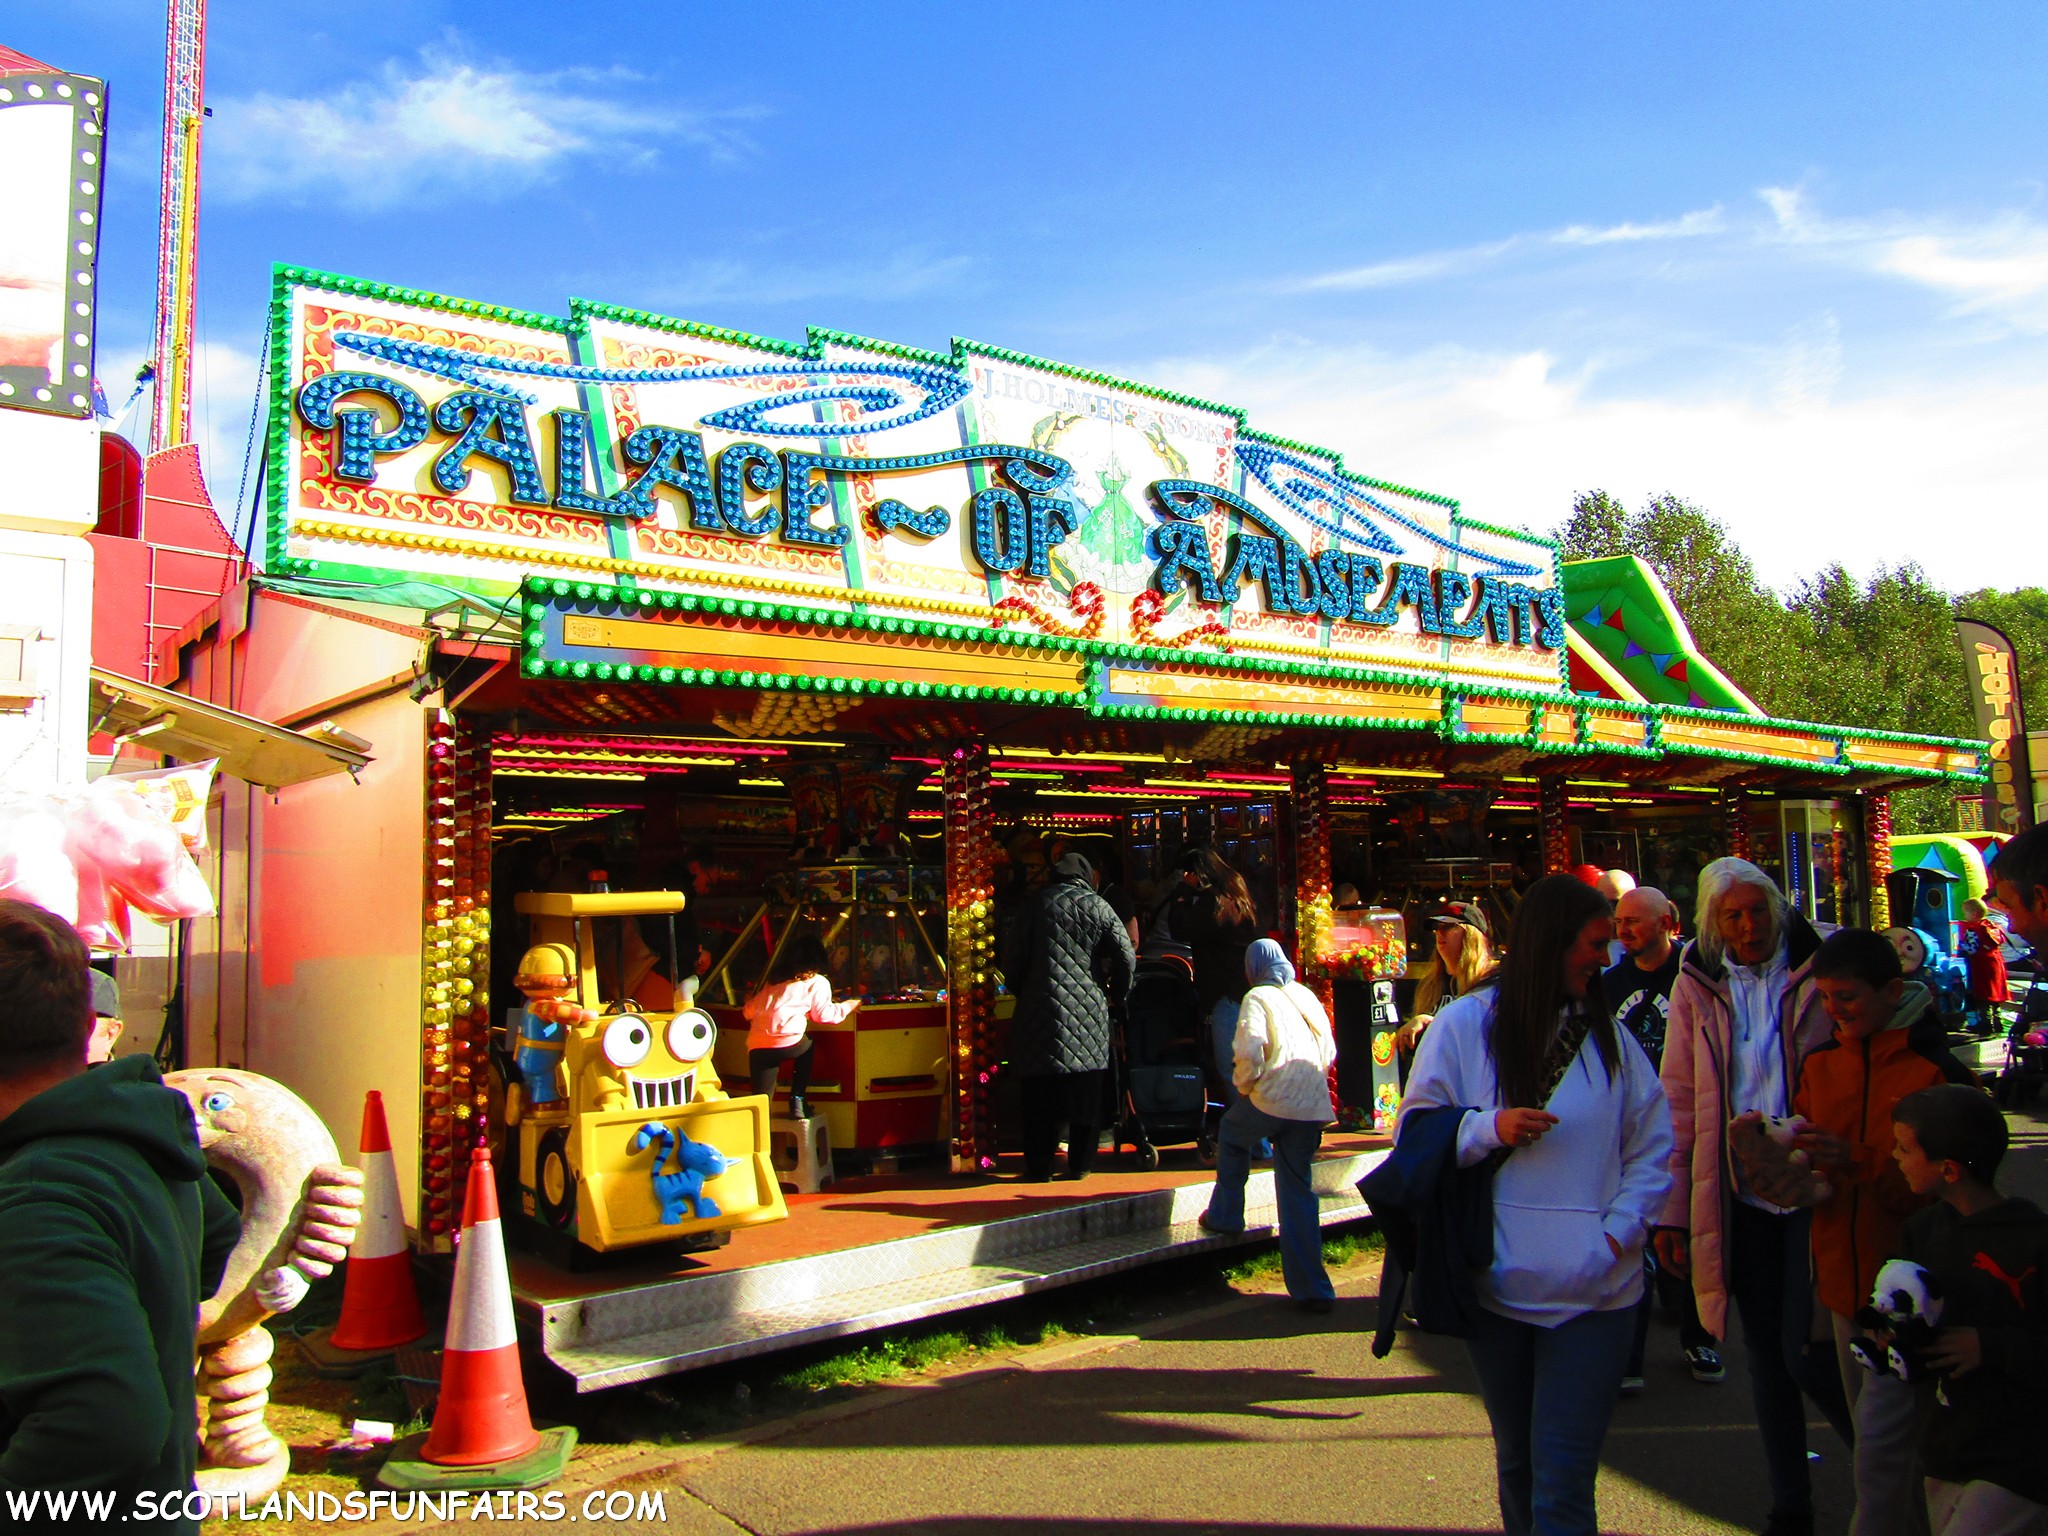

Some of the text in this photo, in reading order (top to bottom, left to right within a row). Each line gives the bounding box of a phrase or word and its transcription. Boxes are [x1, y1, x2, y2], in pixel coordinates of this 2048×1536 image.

[1164, 412, 1226, 446] SONS
[298, 370, 1564, 649] PALACE OF AMUSEMENTS
[1374, 1006, 1384, 1019] £1
